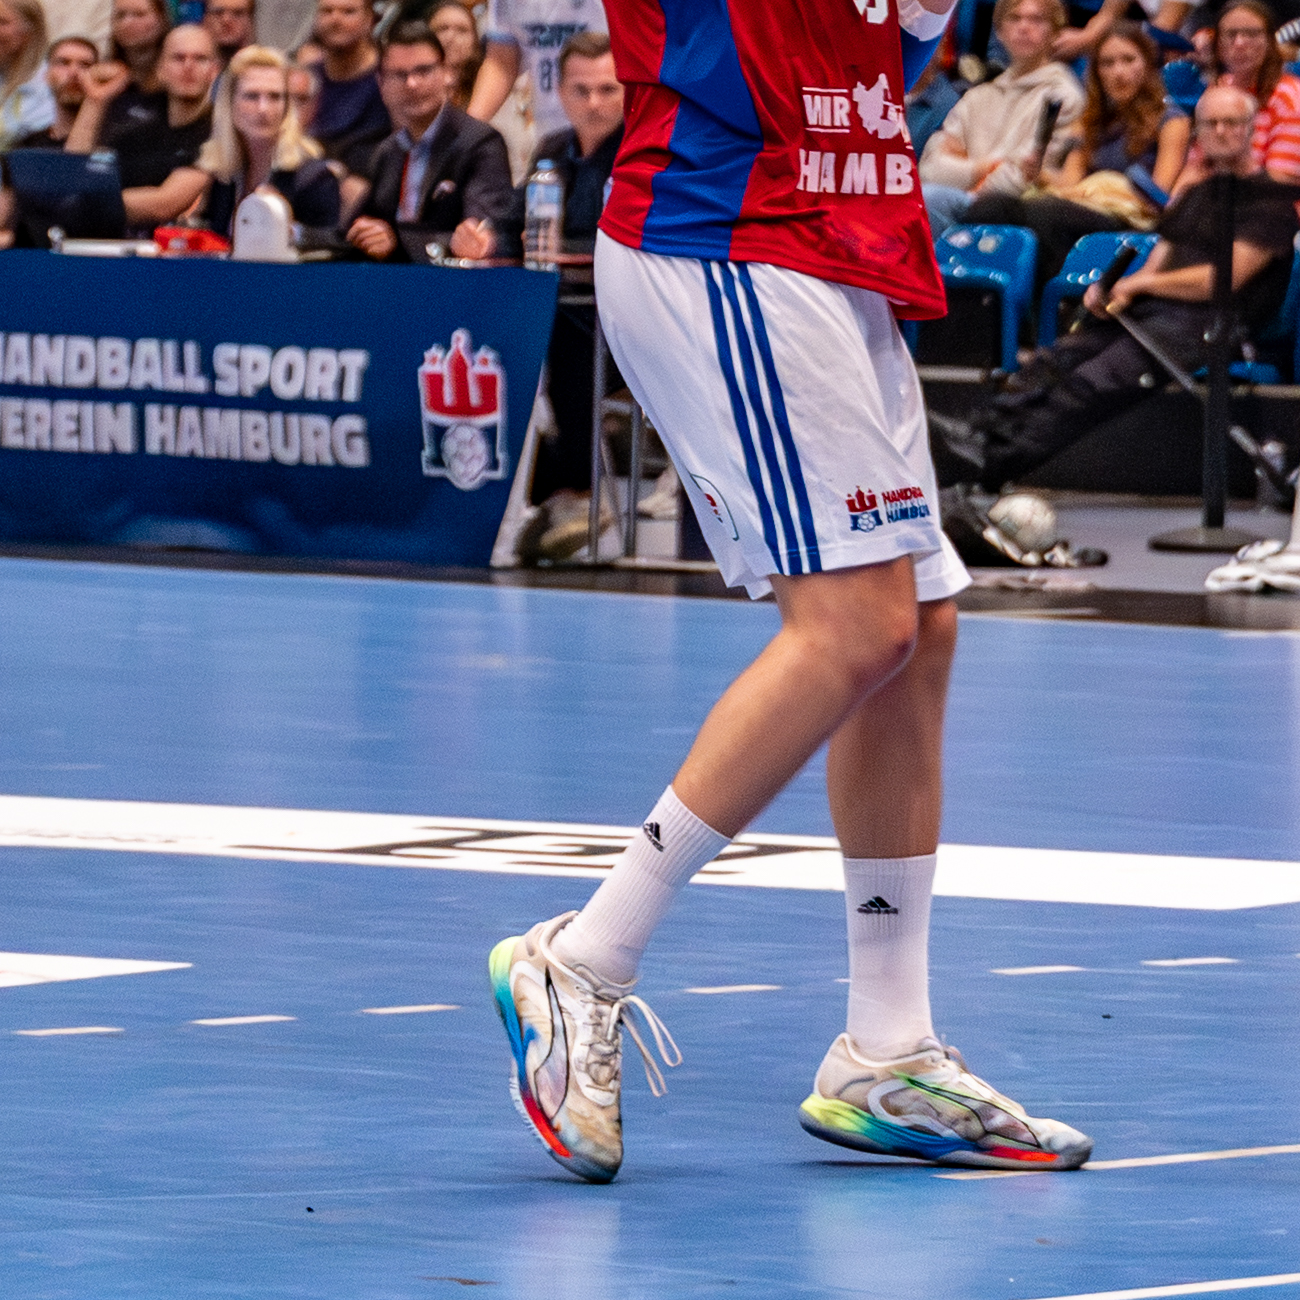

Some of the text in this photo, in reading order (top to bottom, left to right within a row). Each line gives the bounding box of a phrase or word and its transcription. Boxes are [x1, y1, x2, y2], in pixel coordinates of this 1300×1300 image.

[0, 331, 371, 402] ANDBALL SPORT
[145, 402, 371, 468] HAMBURG
